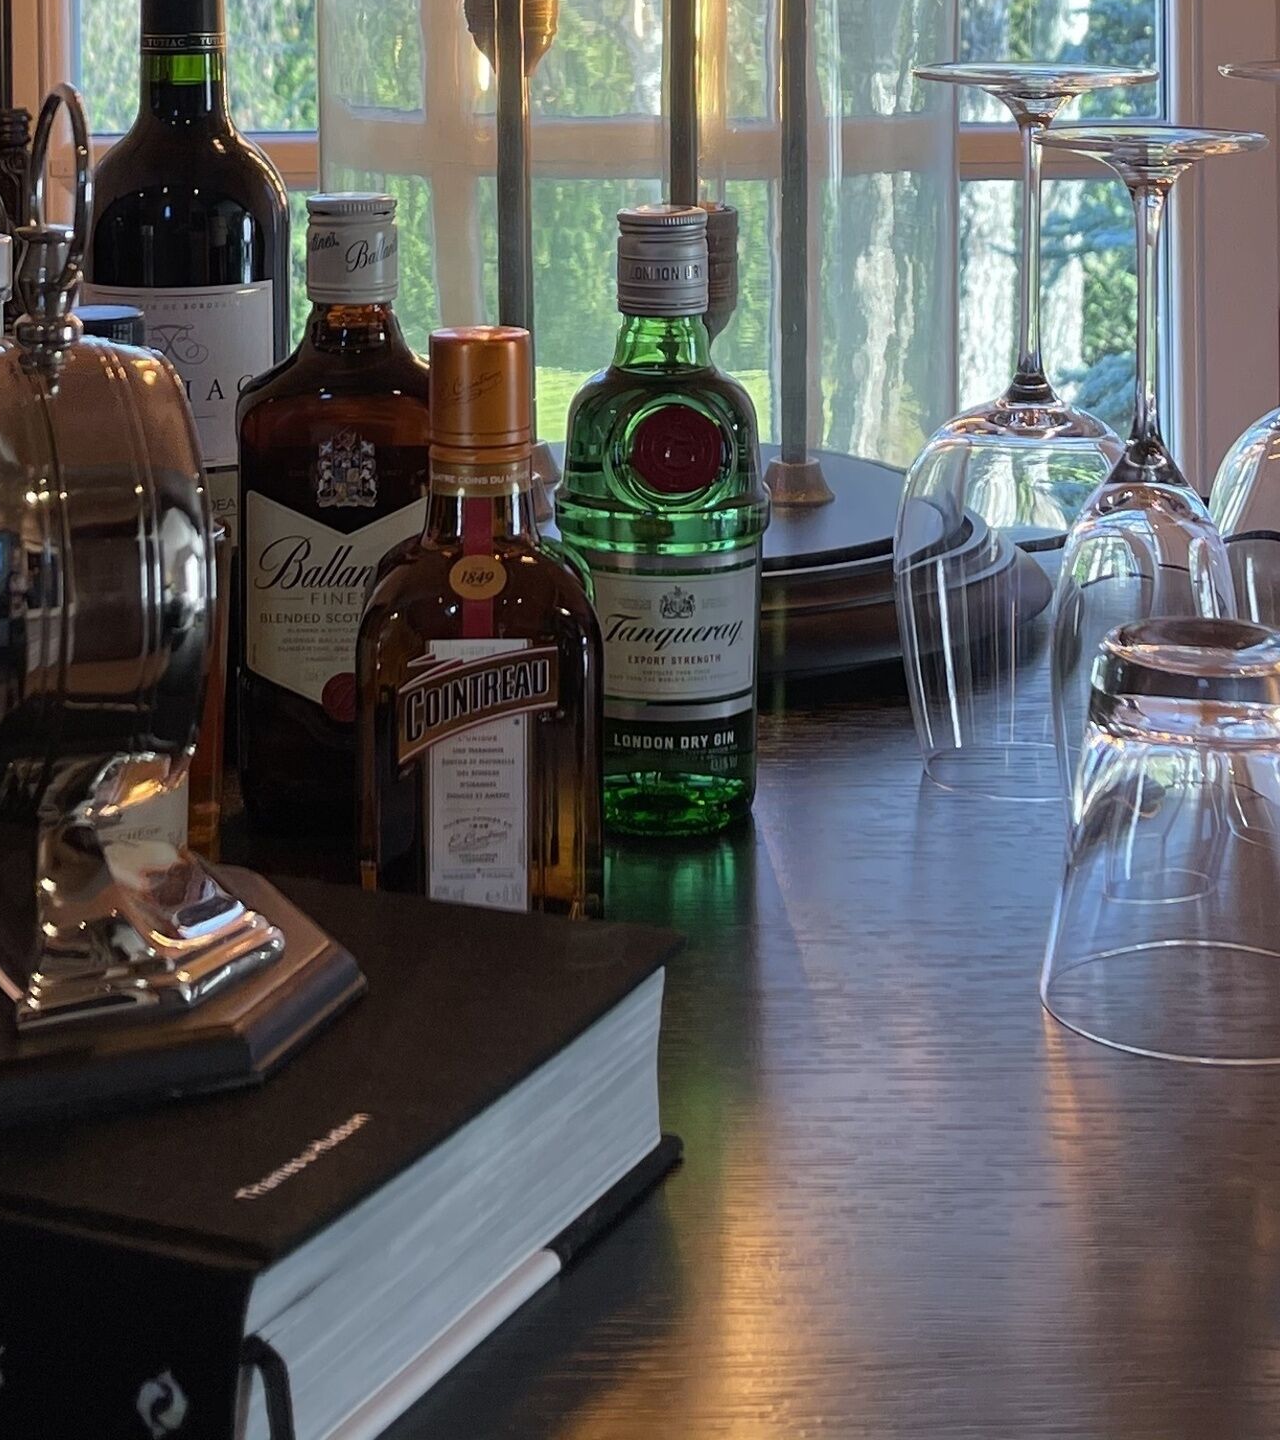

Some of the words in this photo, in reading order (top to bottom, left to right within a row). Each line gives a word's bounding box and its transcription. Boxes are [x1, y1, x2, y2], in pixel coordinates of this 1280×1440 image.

[457, 474, 489, 485] COINS
[490, 474, 504, 485] DU
[254, 535, 377, 590] Ballan
[461, 570, 495, 585] 1849
[260, 613, 321, 624] BLENDED
[325, 613, 360, 624] SCOT
[605, 613, 743, 652] Tanqueray
[628, 654, 666, 665] EXPORT
[671, 654, 721, 665] STRENGTH
[405, 659, 550, 742] COINTREAU
[614, 733, 675, 750] LONDON
[681, 734, 710, 750] DRY
[714, 730, 736, 747] GIN
